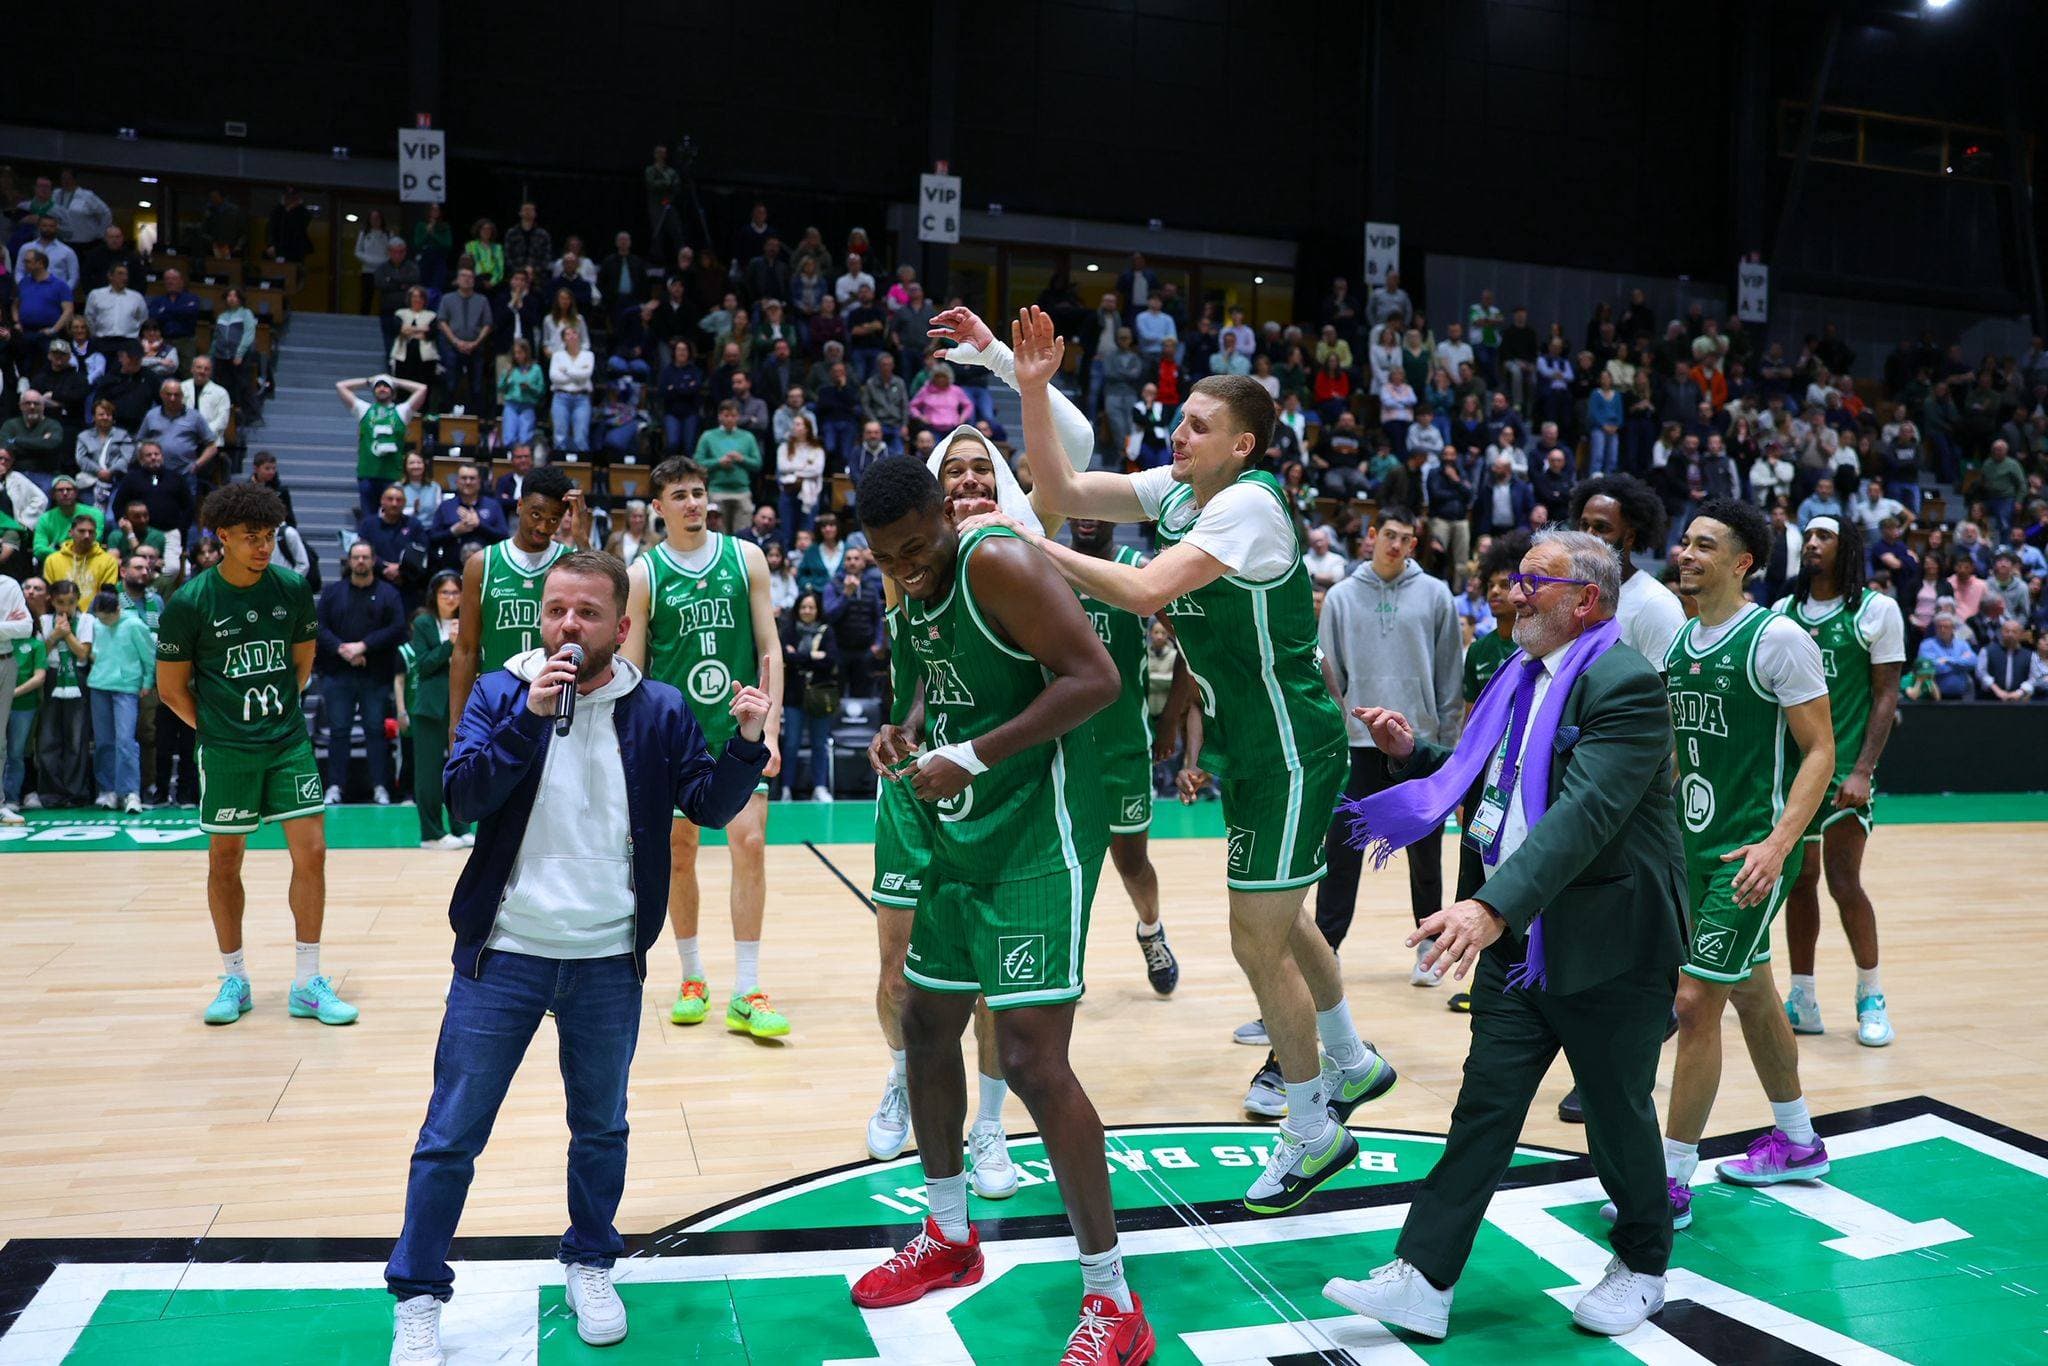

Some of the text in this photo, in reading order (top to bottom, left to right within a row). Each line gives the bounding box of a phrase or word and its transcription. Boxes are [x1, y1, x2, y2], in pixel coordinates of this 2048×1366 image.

[403, 142, 440, 160] VIP
[402, 174, 442, 191] D C
[924, 186, 957, 204] VIP
[922, 215, 956, 233] C B
[1369, 234, 1396, 250] VIP
[1741, 273, 1766, 289] VIP
[679, 598, 735, 637] ADA
[699, 631, 717, 656] 16
[223, 639, 287, 679] ADA
[1688, 736, 1700, 768] 8
